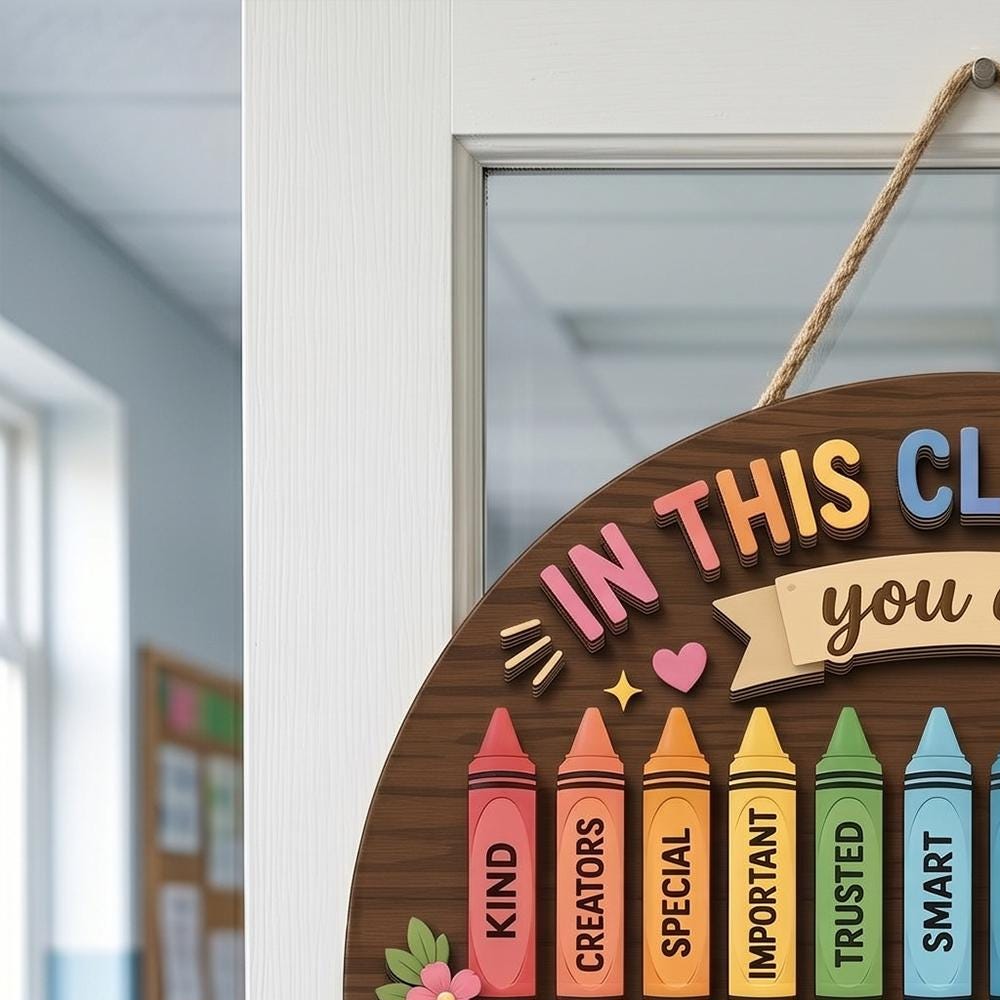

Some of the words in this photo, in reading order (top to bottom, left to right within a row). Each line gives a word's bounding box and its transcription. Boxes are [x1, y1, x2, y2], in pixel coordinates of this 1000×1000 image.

[540, 522, 660, 645] IN
[653, 438, 871, 575] THIS
[822, 579, 973, 656] you
[486, 842, 517, 938] KIND
[576, 817, 604, 973] CREATORS
[661, 827, 691, 958] SPECIAL
[748, 808, 777, 979] IMPORTANT
[835, 820, 864, 968] TRUSTED
[923, 831, 953, 952] SMART
